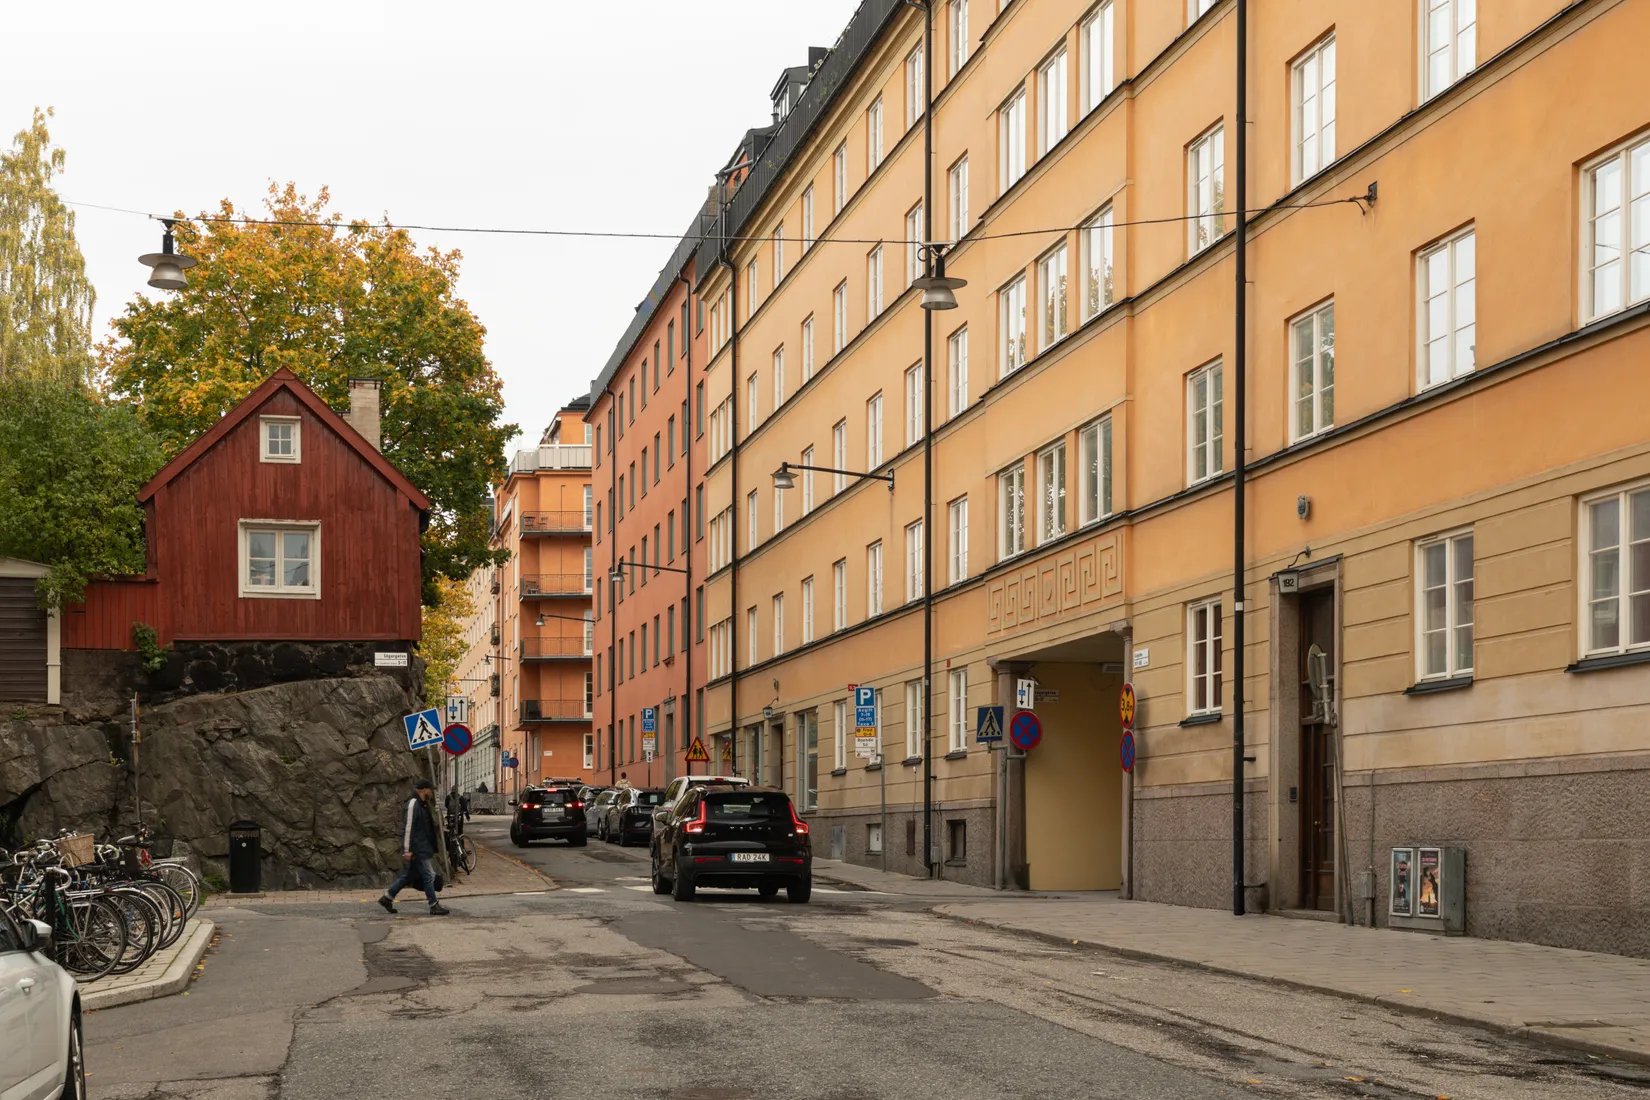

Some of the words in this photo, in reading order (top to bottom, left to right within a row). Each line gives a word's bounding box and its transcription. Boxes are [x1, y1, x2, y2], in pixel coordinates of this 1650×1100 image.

[1283, 579, 1295, 588] 192
[860, 689, 872, 705] P
[645, 709, 653, 719] P
[737, 853, 751, 861] RAD
[752, 853, 767, 861] 24K
